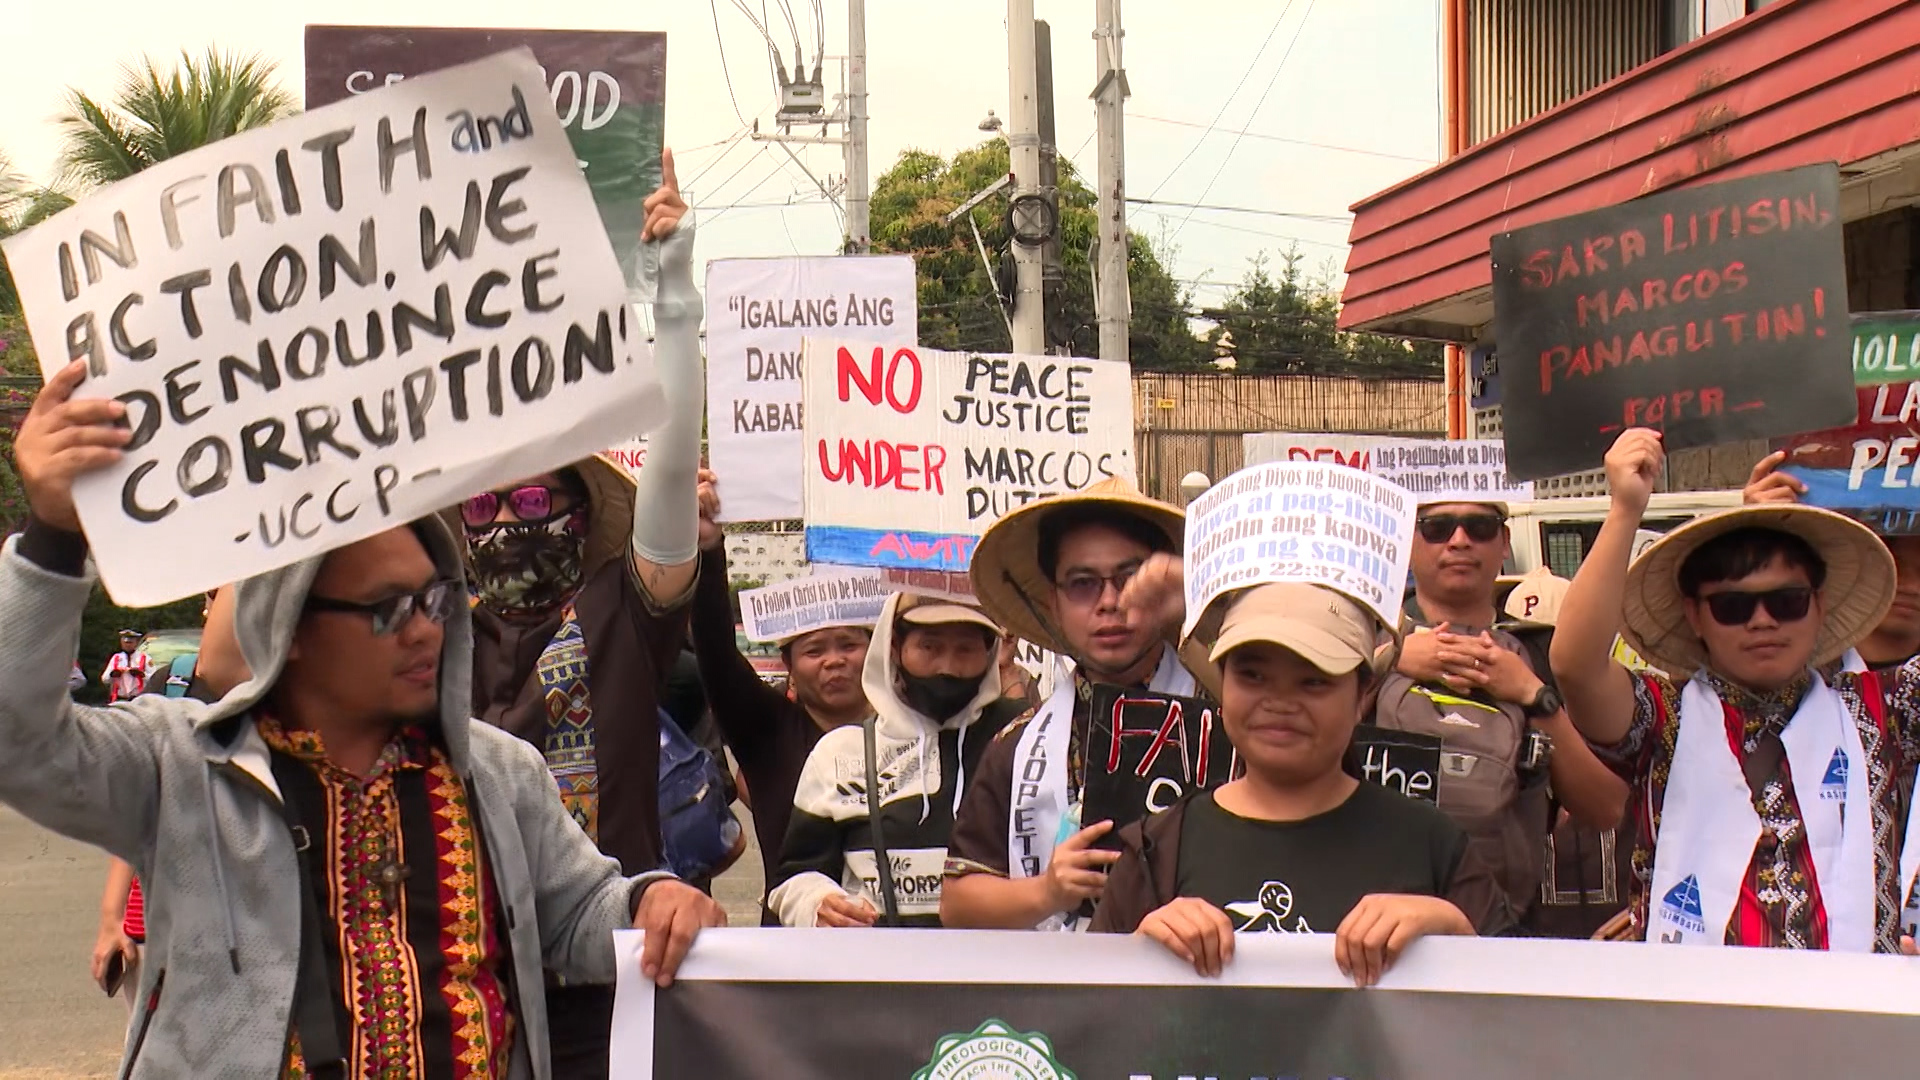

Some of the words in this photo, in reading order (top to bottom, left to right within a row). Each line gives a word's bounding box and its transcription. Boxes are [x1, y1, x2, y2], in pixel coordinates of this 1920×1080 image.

[540, 66, 621, 130] OD
[59, 210, 138, 301] IN
[160, 106, 433, 250] FAITH
[446, 83, 534, 154] and
[420, 165, 538, 271] WE
[1520, 228, 1646, 289] SARA
[1577, 261, 1749, 328] MARCOS
[113, 247, 565, 450] DENOUNCE
[1540, 286, 1827, 396] PANAGUTIN!
[836, 346, 922, 414] NO
[965, 357, 1094, 402] PEACE
[121, 304, 634, 523] CORRUPTION!
[943, 395, 1091, 434] JUSTICE
[819, 438, 946, 495] UNDER
[1376, 447, 1396, 470] Ang
[1467, 446, 1479, 465] sa
[1481, 443, 1505, 468] Diyo
[1473, 472, 1488, 492] sa
[1191, 503, 1239, 548] diwa
[1247, 491, 1273, 514] at
[1193, 482, 1235, 523] Mahalin
[1237, 470, 1262, 496] ang
[1265, 467, 1302, 488] Diyos
[1305, 467, 1324, 489] ng
[1328, 469, 1371, 501] buong
[1374, 483, 1407, 518] puso,
[1191, 518, 1264, 574] Mahalin
[1271, 513, 1317, 536] ang
[1324, 515, 1398, 566] kapwa
[1257, 535, 1300, 560] ng
[750, 595, 763, 616] To
[763, 590, 792, 614] Follow
[793, 582, 818, 608] Christ
[818, 580, 828, 601] is
[828, 579, 838, 601] to
[838, 579, 851, 600] be
[1523, 595, 1539, 617] P
[1106, 694, 1238, 789] FAI
[1362, 745, 1432, 798] the
[936, 1039, 1030, 1079] THEOLOGICAL
